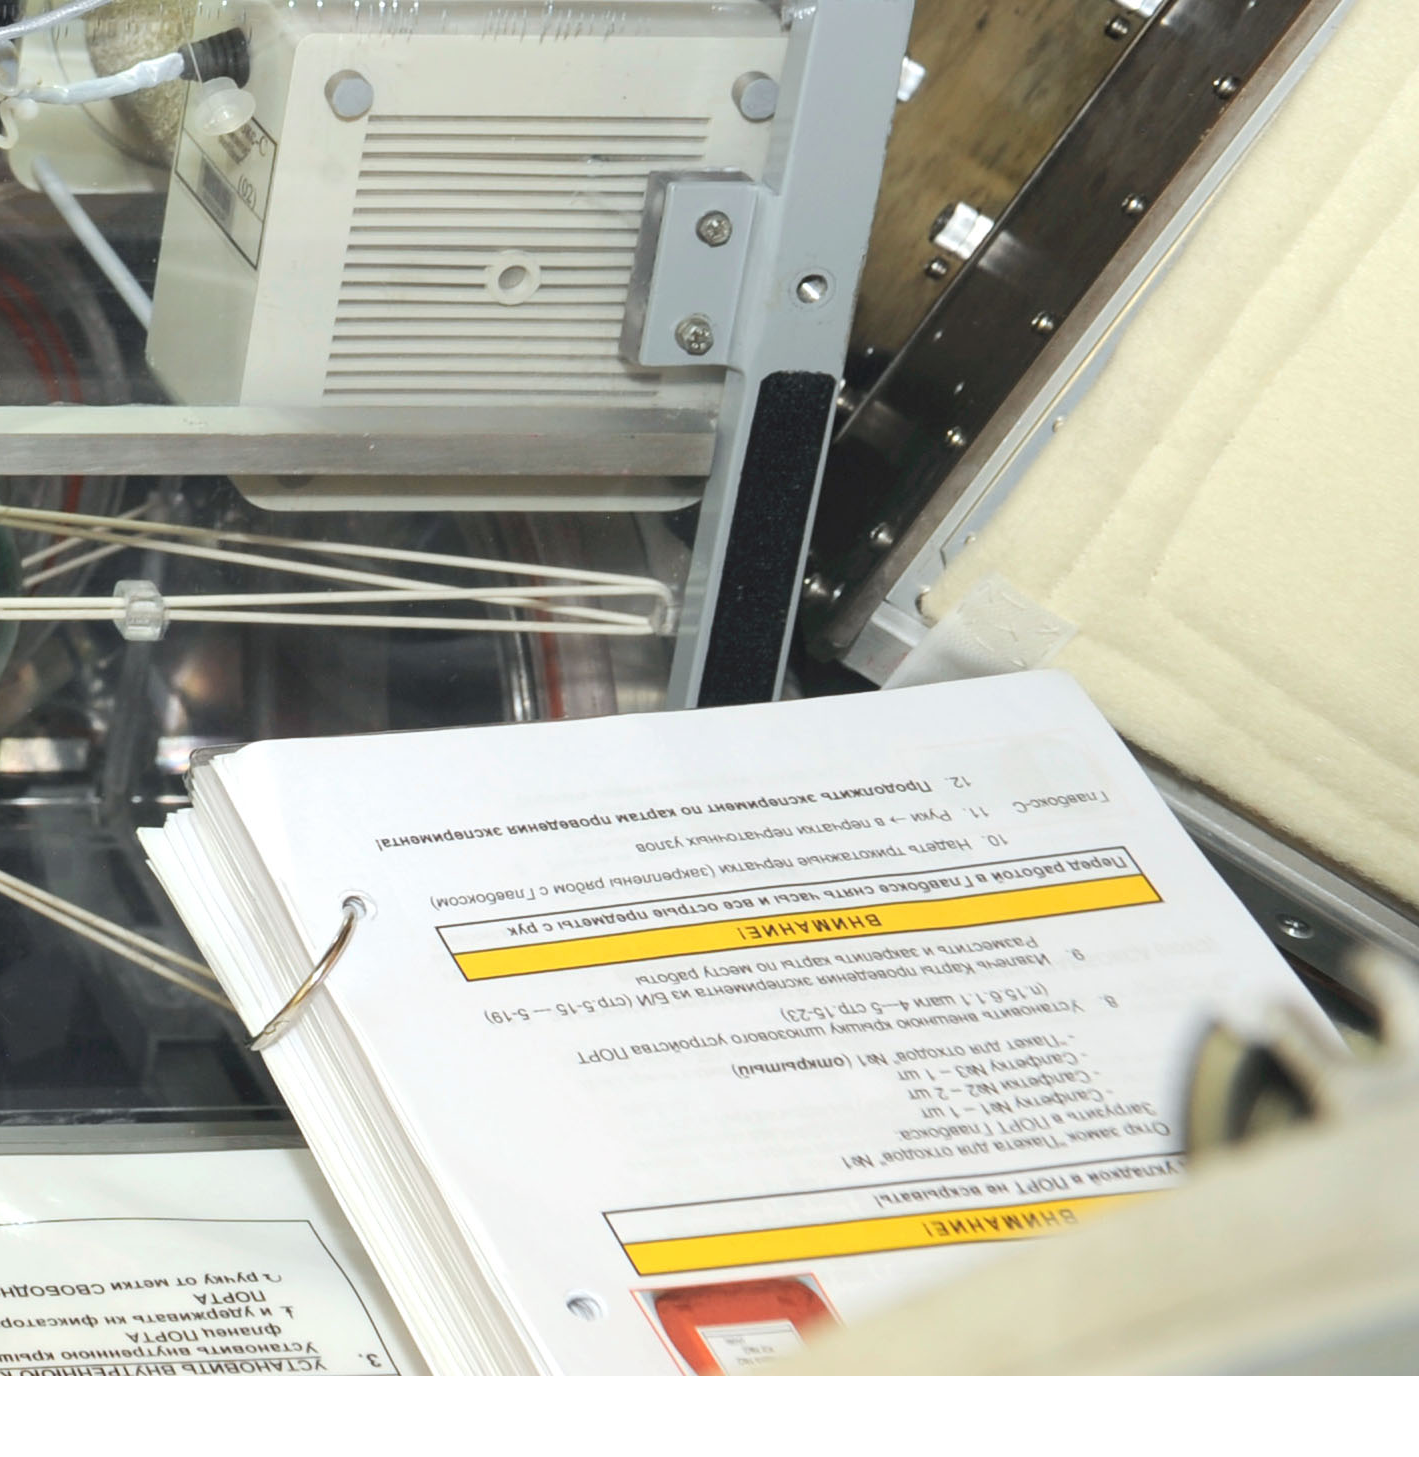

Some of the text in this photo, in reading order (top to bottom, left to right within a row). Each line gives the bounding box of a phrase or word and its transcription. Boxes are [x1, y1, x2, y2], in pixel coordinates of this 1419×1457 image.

[1013, 792, 1110, 814] Главбокс-С
[376, 777, 971, 852] 12. Продолжить эксперимент картам проведения эксперимента!
[636, 808, 989, 853] 11. Руки перчатки перчаточных узлов
[431, 835, 1008, 911] 10. Надеть трикотажные перчатки (закреплены рядом Главбоксом)
[507, 857, 1128, 936] Перед работой Главбоксе снять часы все острые предметы рук
[738, 915, 882, 940] ВНИМАНИЕ!
[636, 937, 1039, 985] Разместить закрепить карты месту работы
[977, 954, 1051, 970] Извлечь
[1064, 949, 1086, 961] 9.
[816, 967, 918, 985] проведения
[920, 962, 976, 975] Карты
[695, 977, 814, 998] эксперимента
[636, 993, 670, 1007] Б/И
[913, 996, 957, 1008] шаги
[485, 1009, 530, 1024] 5-19)
[578, 996, 1119, 1064] 8. Установить внешнюю крышку шлюзового устройства ПОРТ
[991, 1053, 1079, 1072] Салфетку
[898, 1071, 921, 1081] шт
[1000, 1071, 1092, 1090] Салфетки
[908, 1089, 932, 1100] шт
[1015, 1090, 1104, 1109] Салфетку
[922, 1108, 945, 1119] шт
[924, 1210, 1075, 1237] ВНИМАНИЕ!
[111, 1279, 170, 1291] метки
[205, 1273, 259, 1285] ручку
[194, 1291, 267, 1305] ПОРТА
[133, 1306, 255, 1324] удерживать
[126, 1324, 282, 1344] фланец ПОРТА
[62, 1346, 191, 1366] внутреннюю
[197, 1343, 318, 1355] Установить
[359, 1354, 382, 1368] 3.
